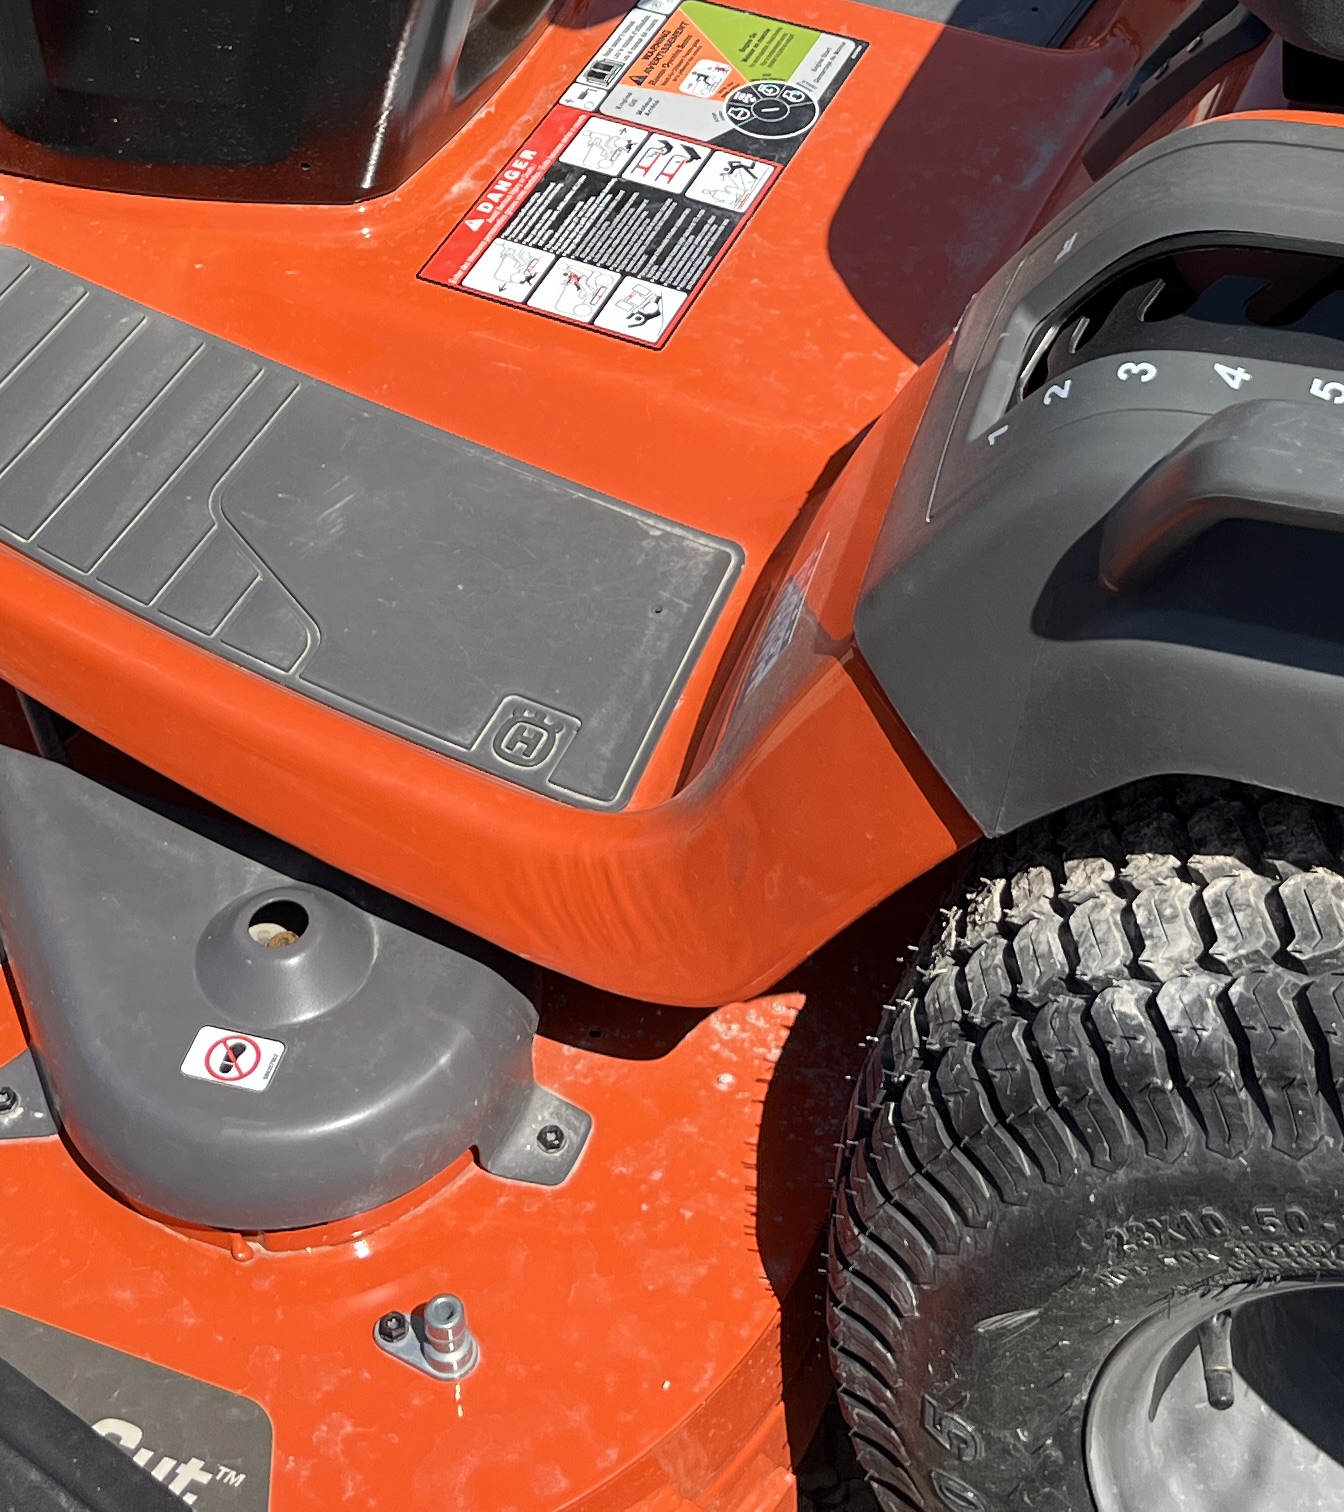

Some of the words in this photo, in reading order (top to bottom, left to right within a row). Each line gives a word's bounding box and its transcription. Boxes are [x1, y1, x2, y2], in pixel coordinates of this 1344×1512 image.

[474, 147, 539, 214] DANGER
[1043, 379, 1073, 407] 2
[1116, 361, 1158, 384] 3
[1213, 361, 1253, 390] 4
